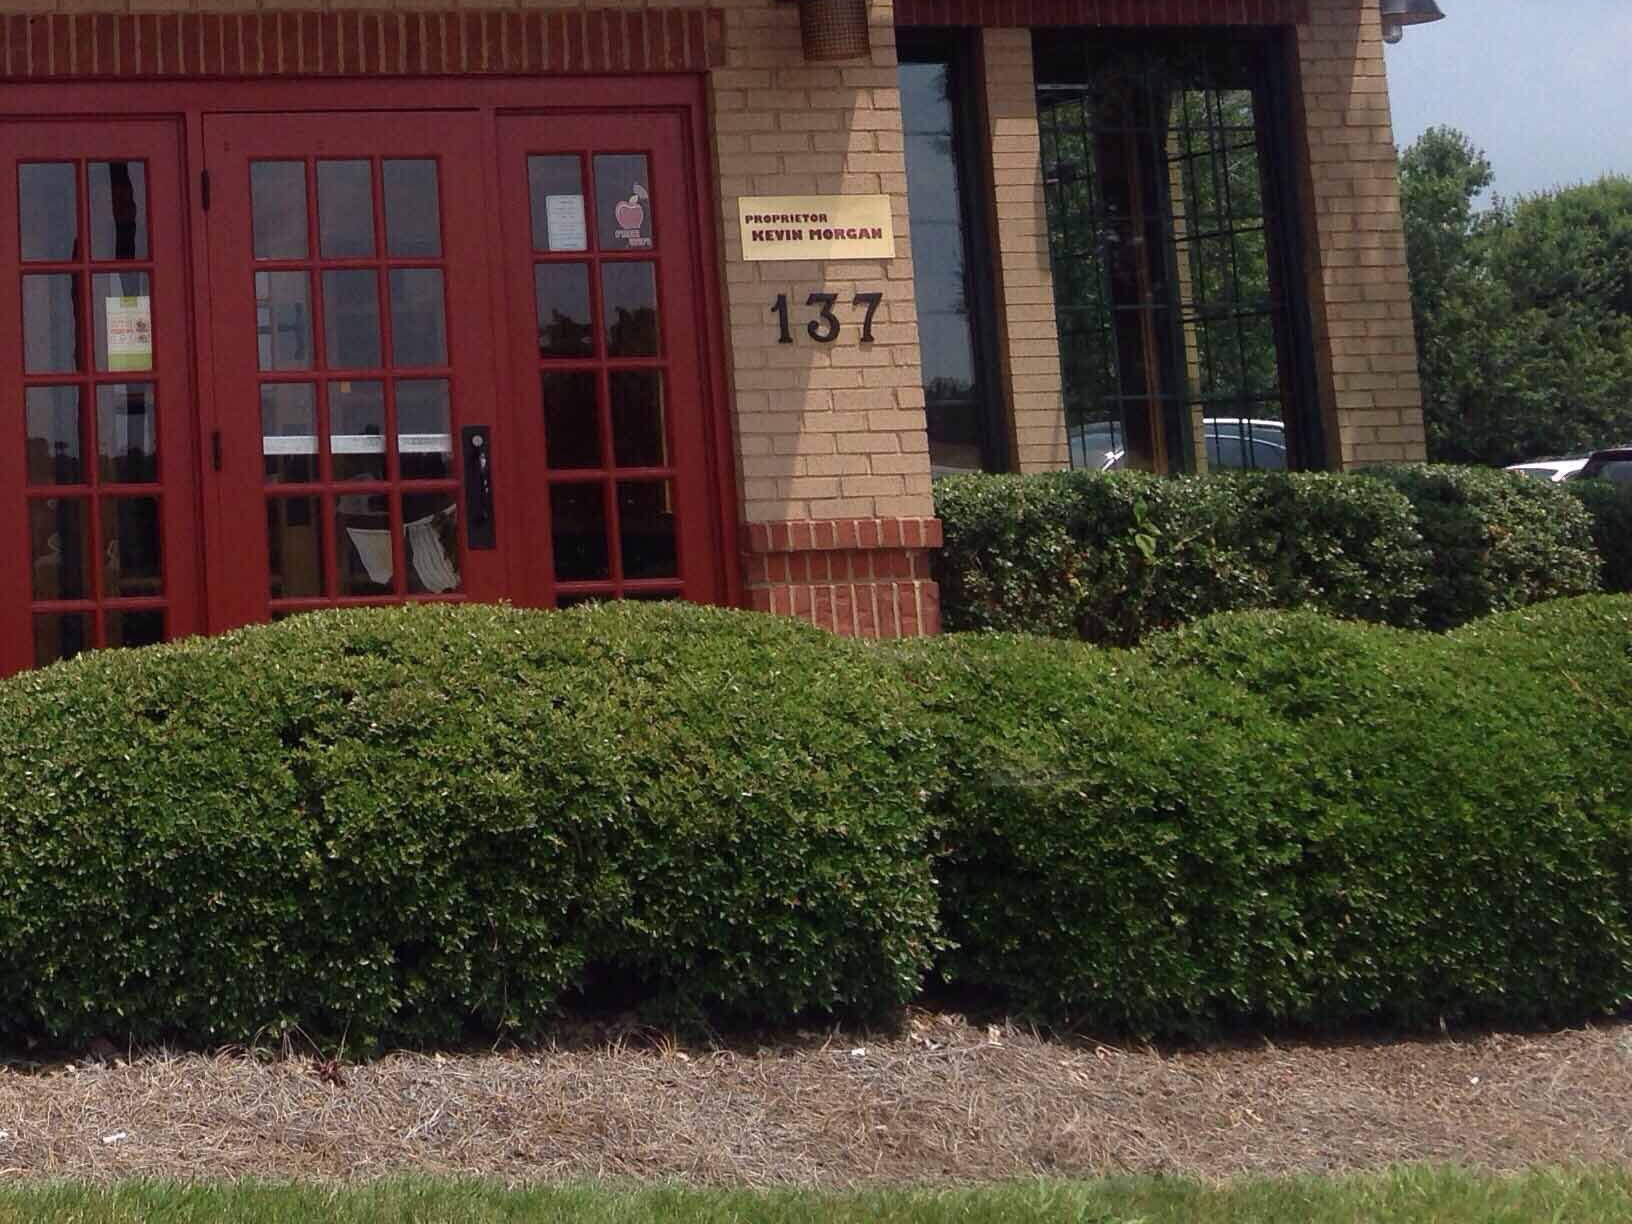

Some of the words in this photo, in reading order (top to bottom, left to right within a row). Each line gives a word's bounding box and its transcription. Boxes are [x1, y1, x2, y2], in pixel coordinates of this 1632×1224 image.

[744, 213, 829, 225] PROPRIETOR
[751, 228, 804, 242] KEVIN
[808, 226, 884, 240] MORGAN
[770, 292, 884, 344] 137
